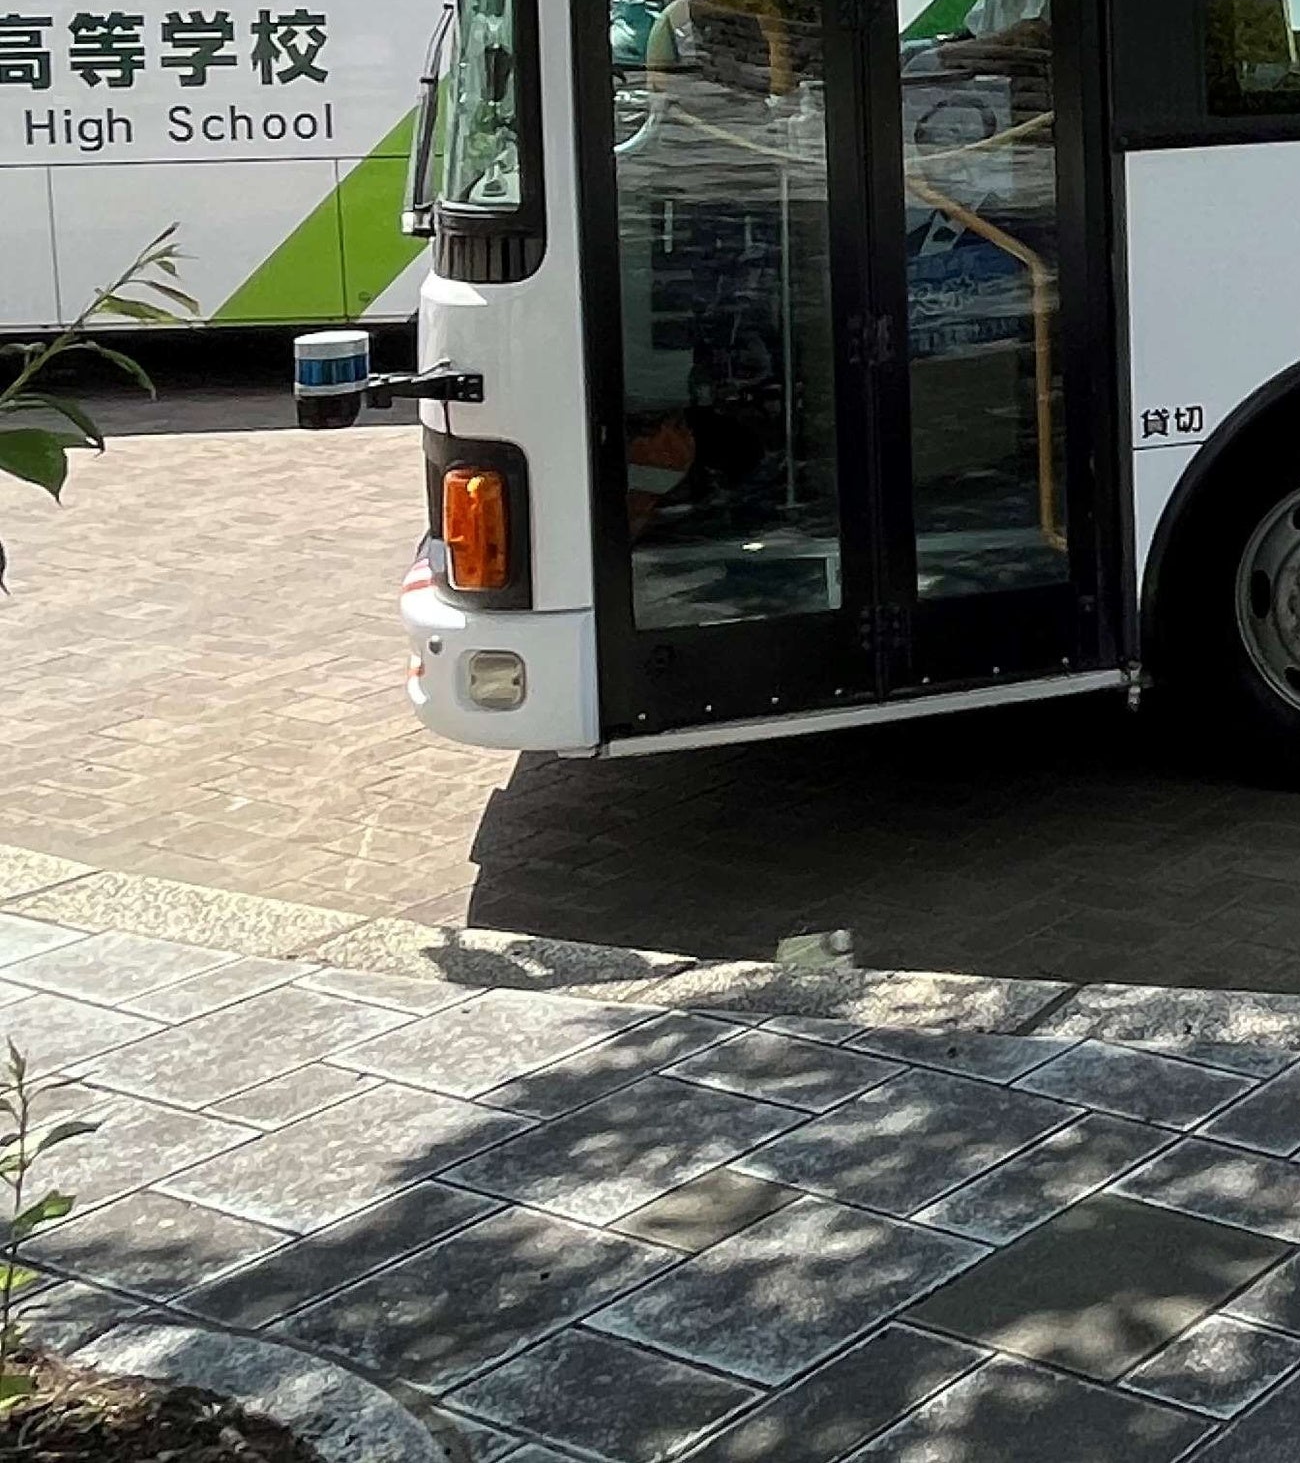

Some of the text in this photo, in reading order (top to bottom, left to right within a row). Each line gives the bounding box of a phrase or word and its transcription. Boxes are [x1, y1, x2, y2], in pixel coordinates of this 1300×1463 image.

[0, 8, 329, 90] 高等学校
[25, 103, 333, 151] High School
[1140, 405, 1203, 438] 貸切
